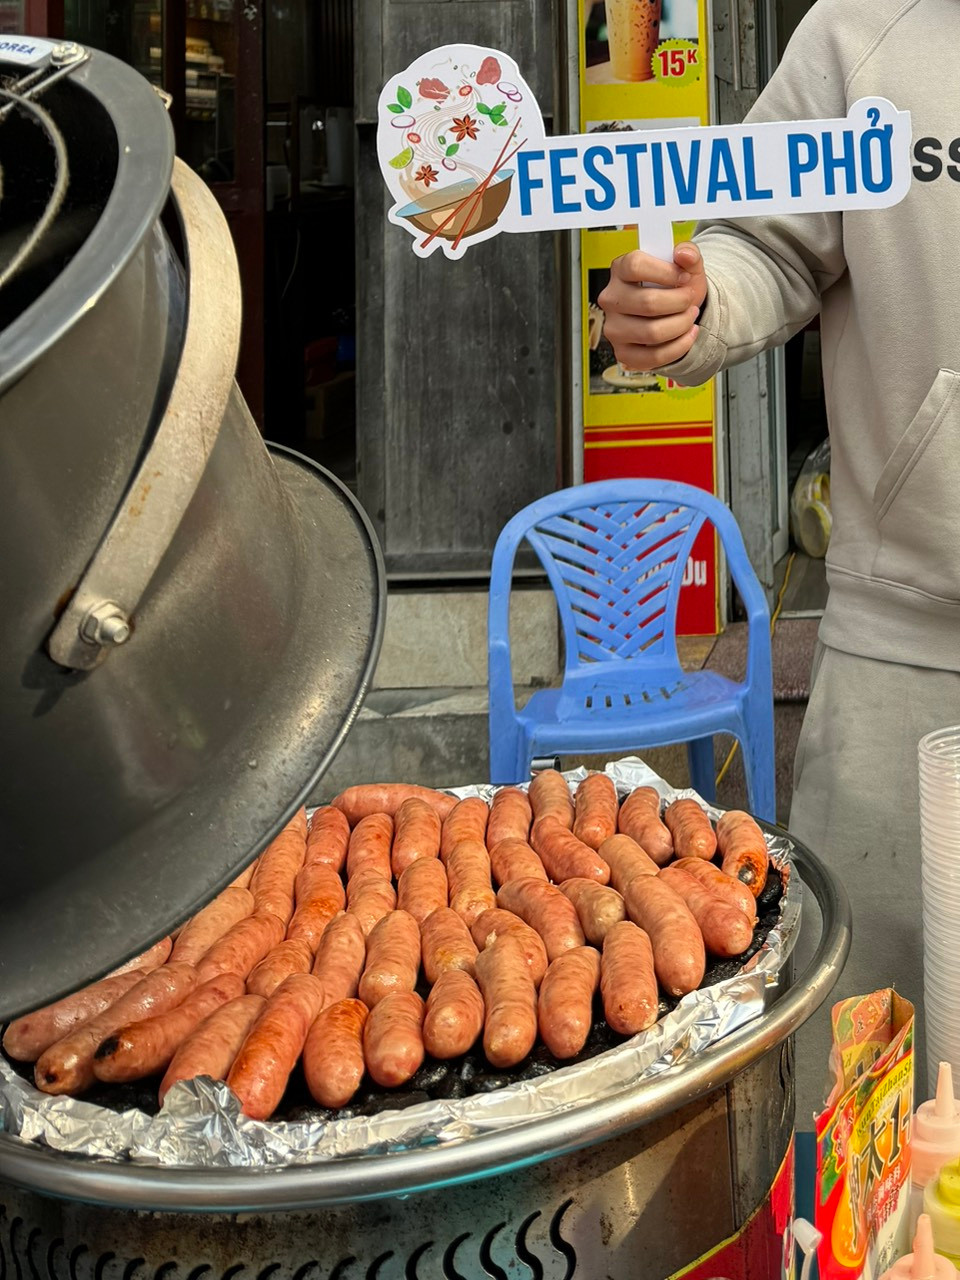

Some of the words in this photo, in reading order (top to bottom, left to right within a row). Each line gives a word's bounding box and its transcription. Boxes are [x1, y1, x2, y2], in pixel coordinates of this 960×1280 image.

[0, 42, 36, 55] OREA
[658, 48, 698, 77] 15K
[516, 136, 773, 217] FESTIVAL
[787, 107, 894, 198] PHỞ
